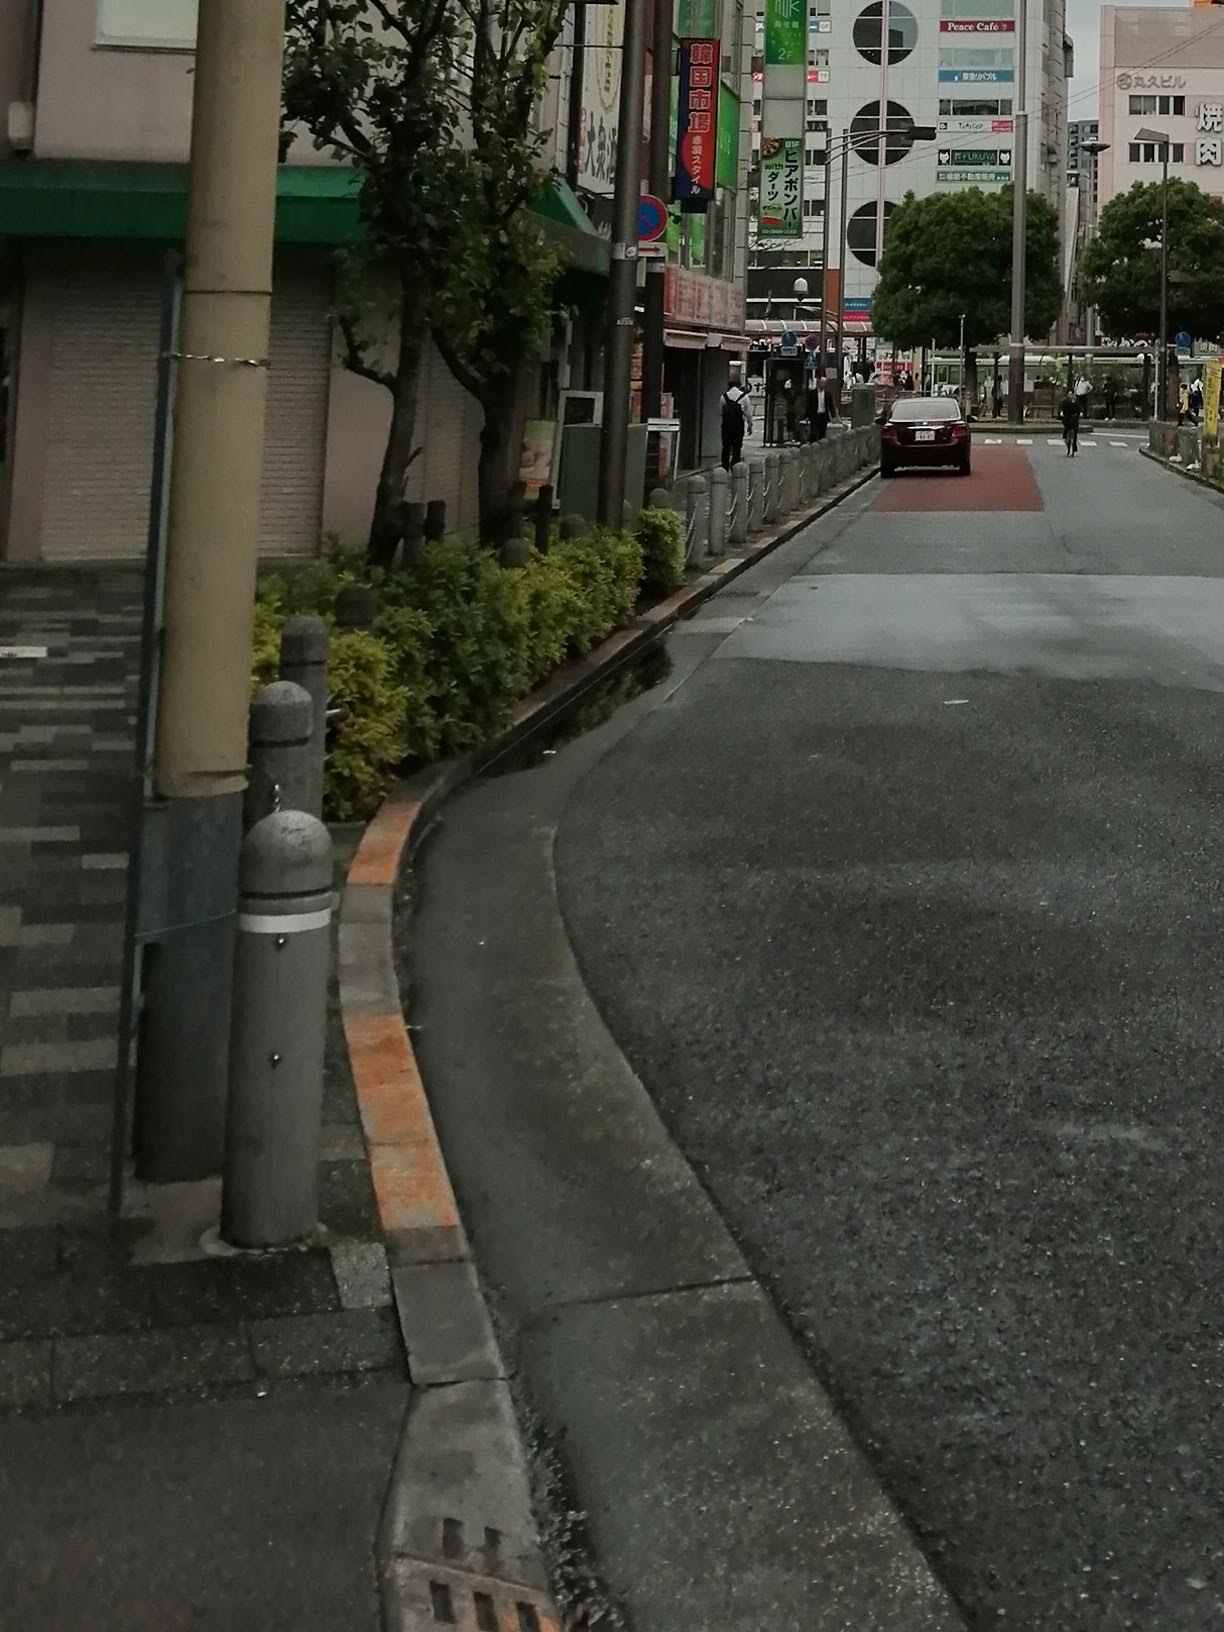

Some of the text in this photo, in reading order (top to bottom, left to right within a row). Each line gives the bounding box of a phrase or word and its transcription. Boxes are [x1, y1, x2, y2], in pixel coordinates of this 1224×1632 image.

[947, 22, 975, 31] Peace
[688, 44, 713, 133] 韓国市場
[1133, 75, 1186, 89] 丸久ビル
[1195, 102, 1223, 167] 焼肉
[768, 171, 779, 201] ダーツ
